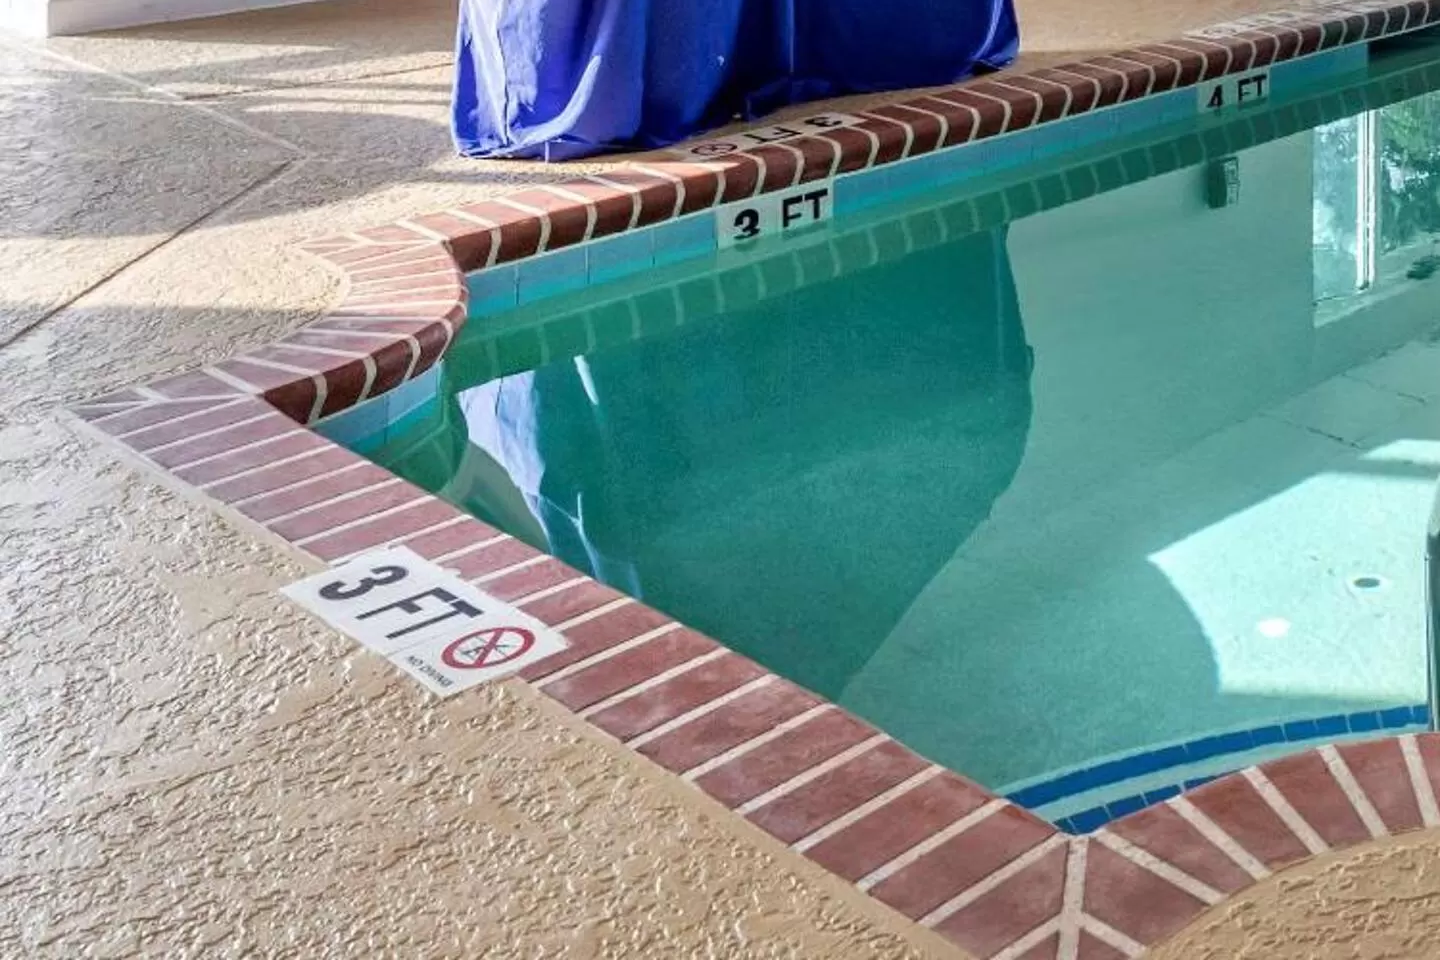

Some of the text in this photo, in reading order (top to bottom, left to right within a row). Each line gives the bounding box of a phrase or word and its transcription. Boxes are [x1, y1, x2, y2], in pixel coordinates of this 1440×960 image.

[1206, 74, 1268, 108] 4 FT
[733, 188, 828, 240] 3 FT
[318, 565, 486, 641] 3 FT
